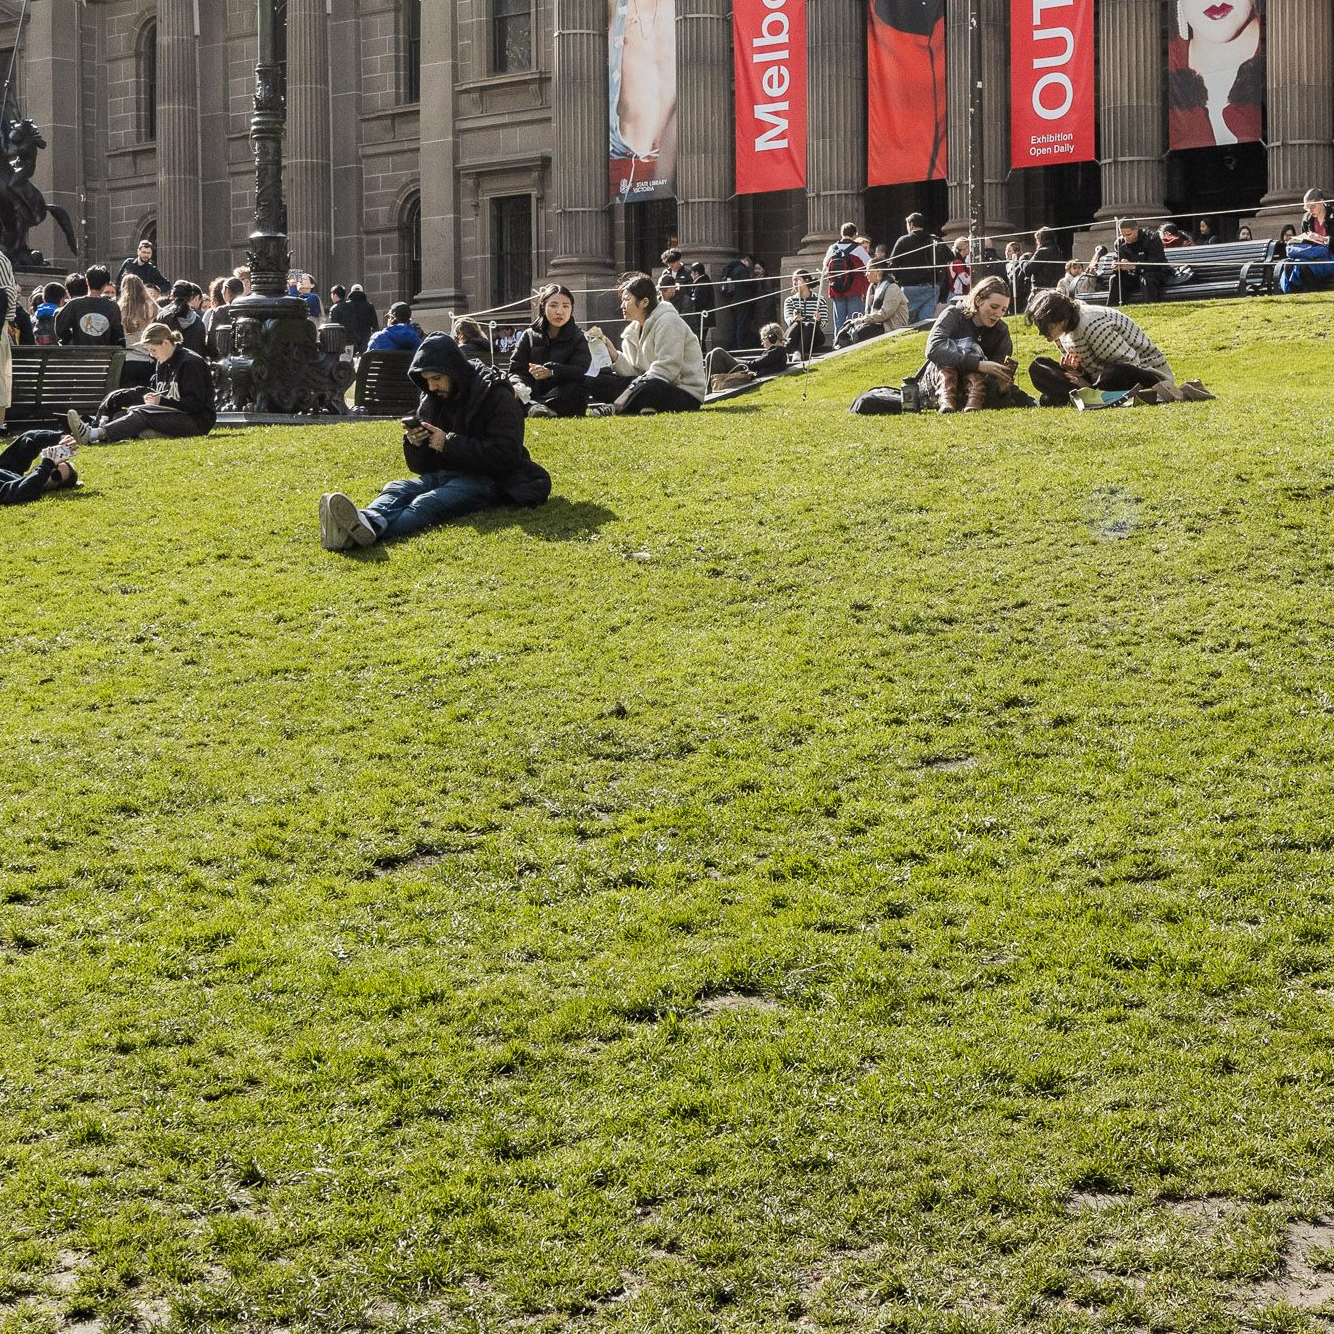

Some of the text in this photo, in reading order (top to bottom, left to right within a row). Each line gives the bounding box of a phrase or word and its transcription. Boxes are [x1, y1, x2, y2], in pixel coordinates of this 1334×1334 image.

[1030, 133, 1073, 145] Exhibition
[1029, 143, 1075, 156] Open Daily
